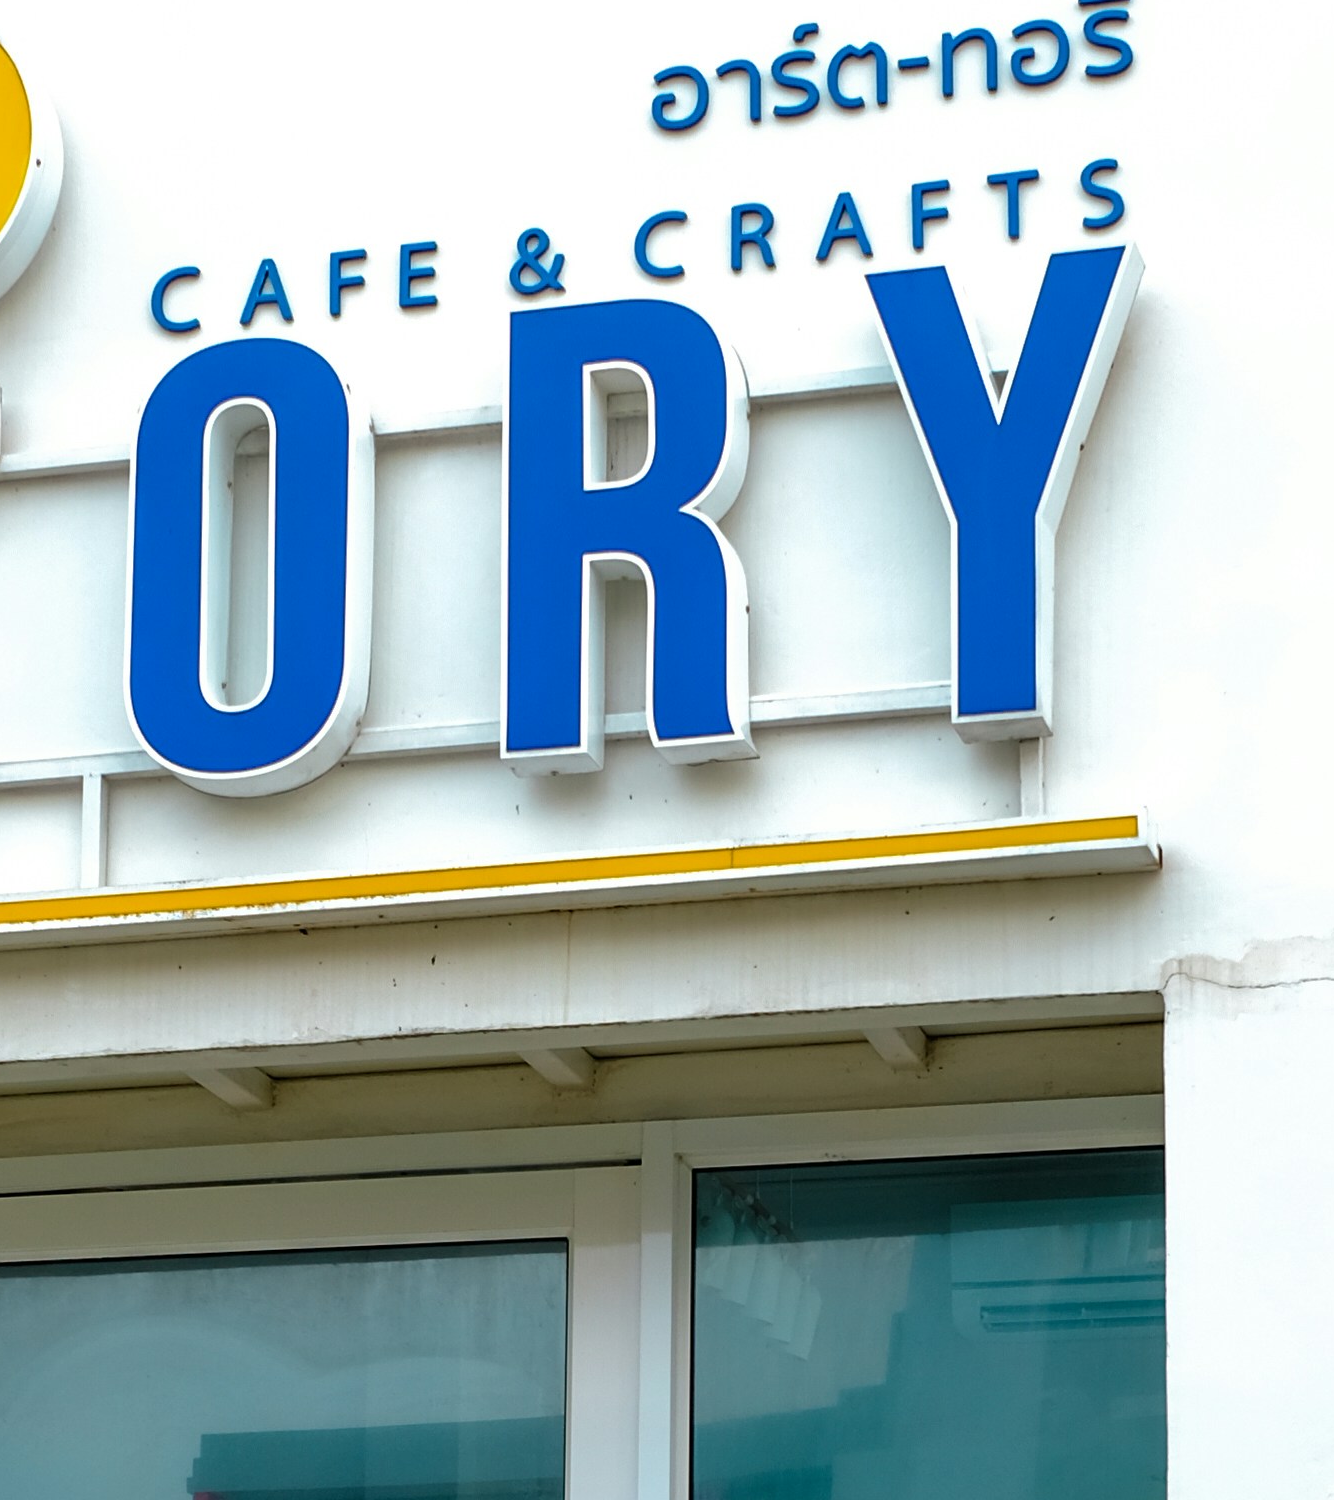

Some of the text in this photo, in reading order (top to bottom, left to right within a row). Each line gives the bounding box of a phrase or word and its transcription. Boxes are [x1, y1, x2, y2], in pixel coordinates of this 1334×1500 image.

[149, 157, 1127, 332] CAFE & CRAFTS
